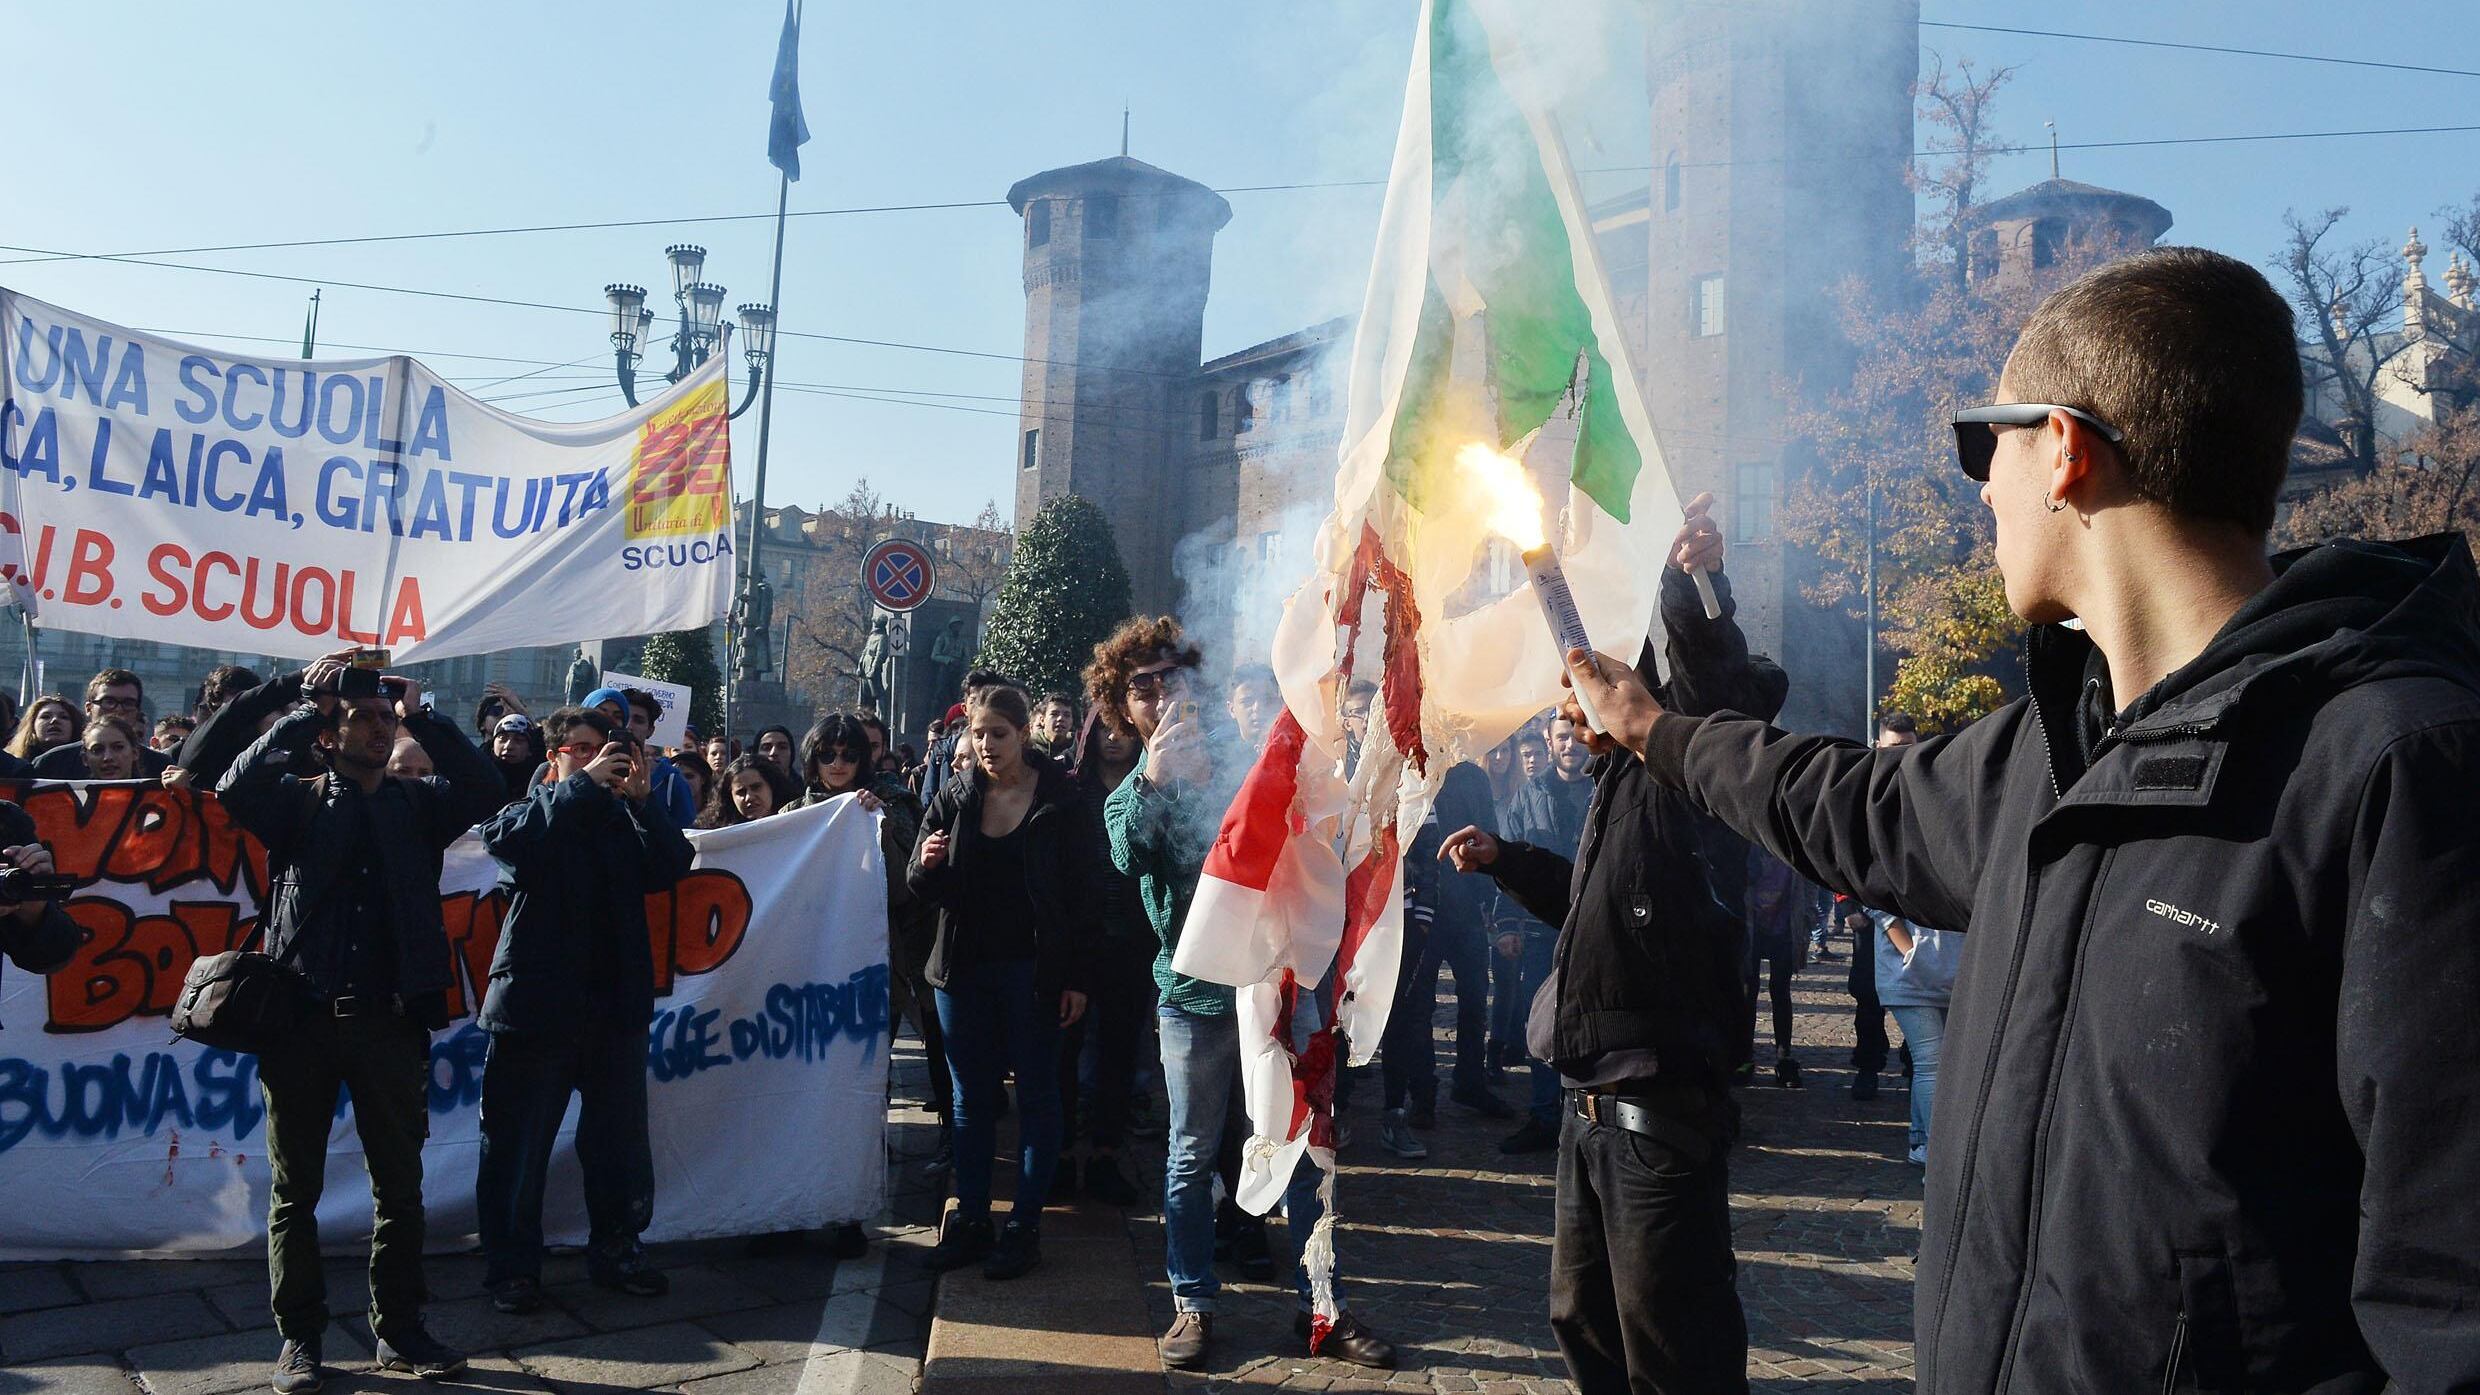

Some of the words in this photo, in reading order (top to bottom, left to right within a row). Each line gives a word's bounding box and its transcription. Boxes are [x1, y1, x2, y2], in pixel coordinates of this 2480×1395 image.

[15, 315, 149, 416] UNA
[174, 354, 452, 462] SCUOLA
[88, 416, 306, 532] LAICA,
[315, 456, 610, 542] GRATUITA
[141, 543, 427, 646] SCUOLA
[2146, 898, 2220, 935] carhartt
